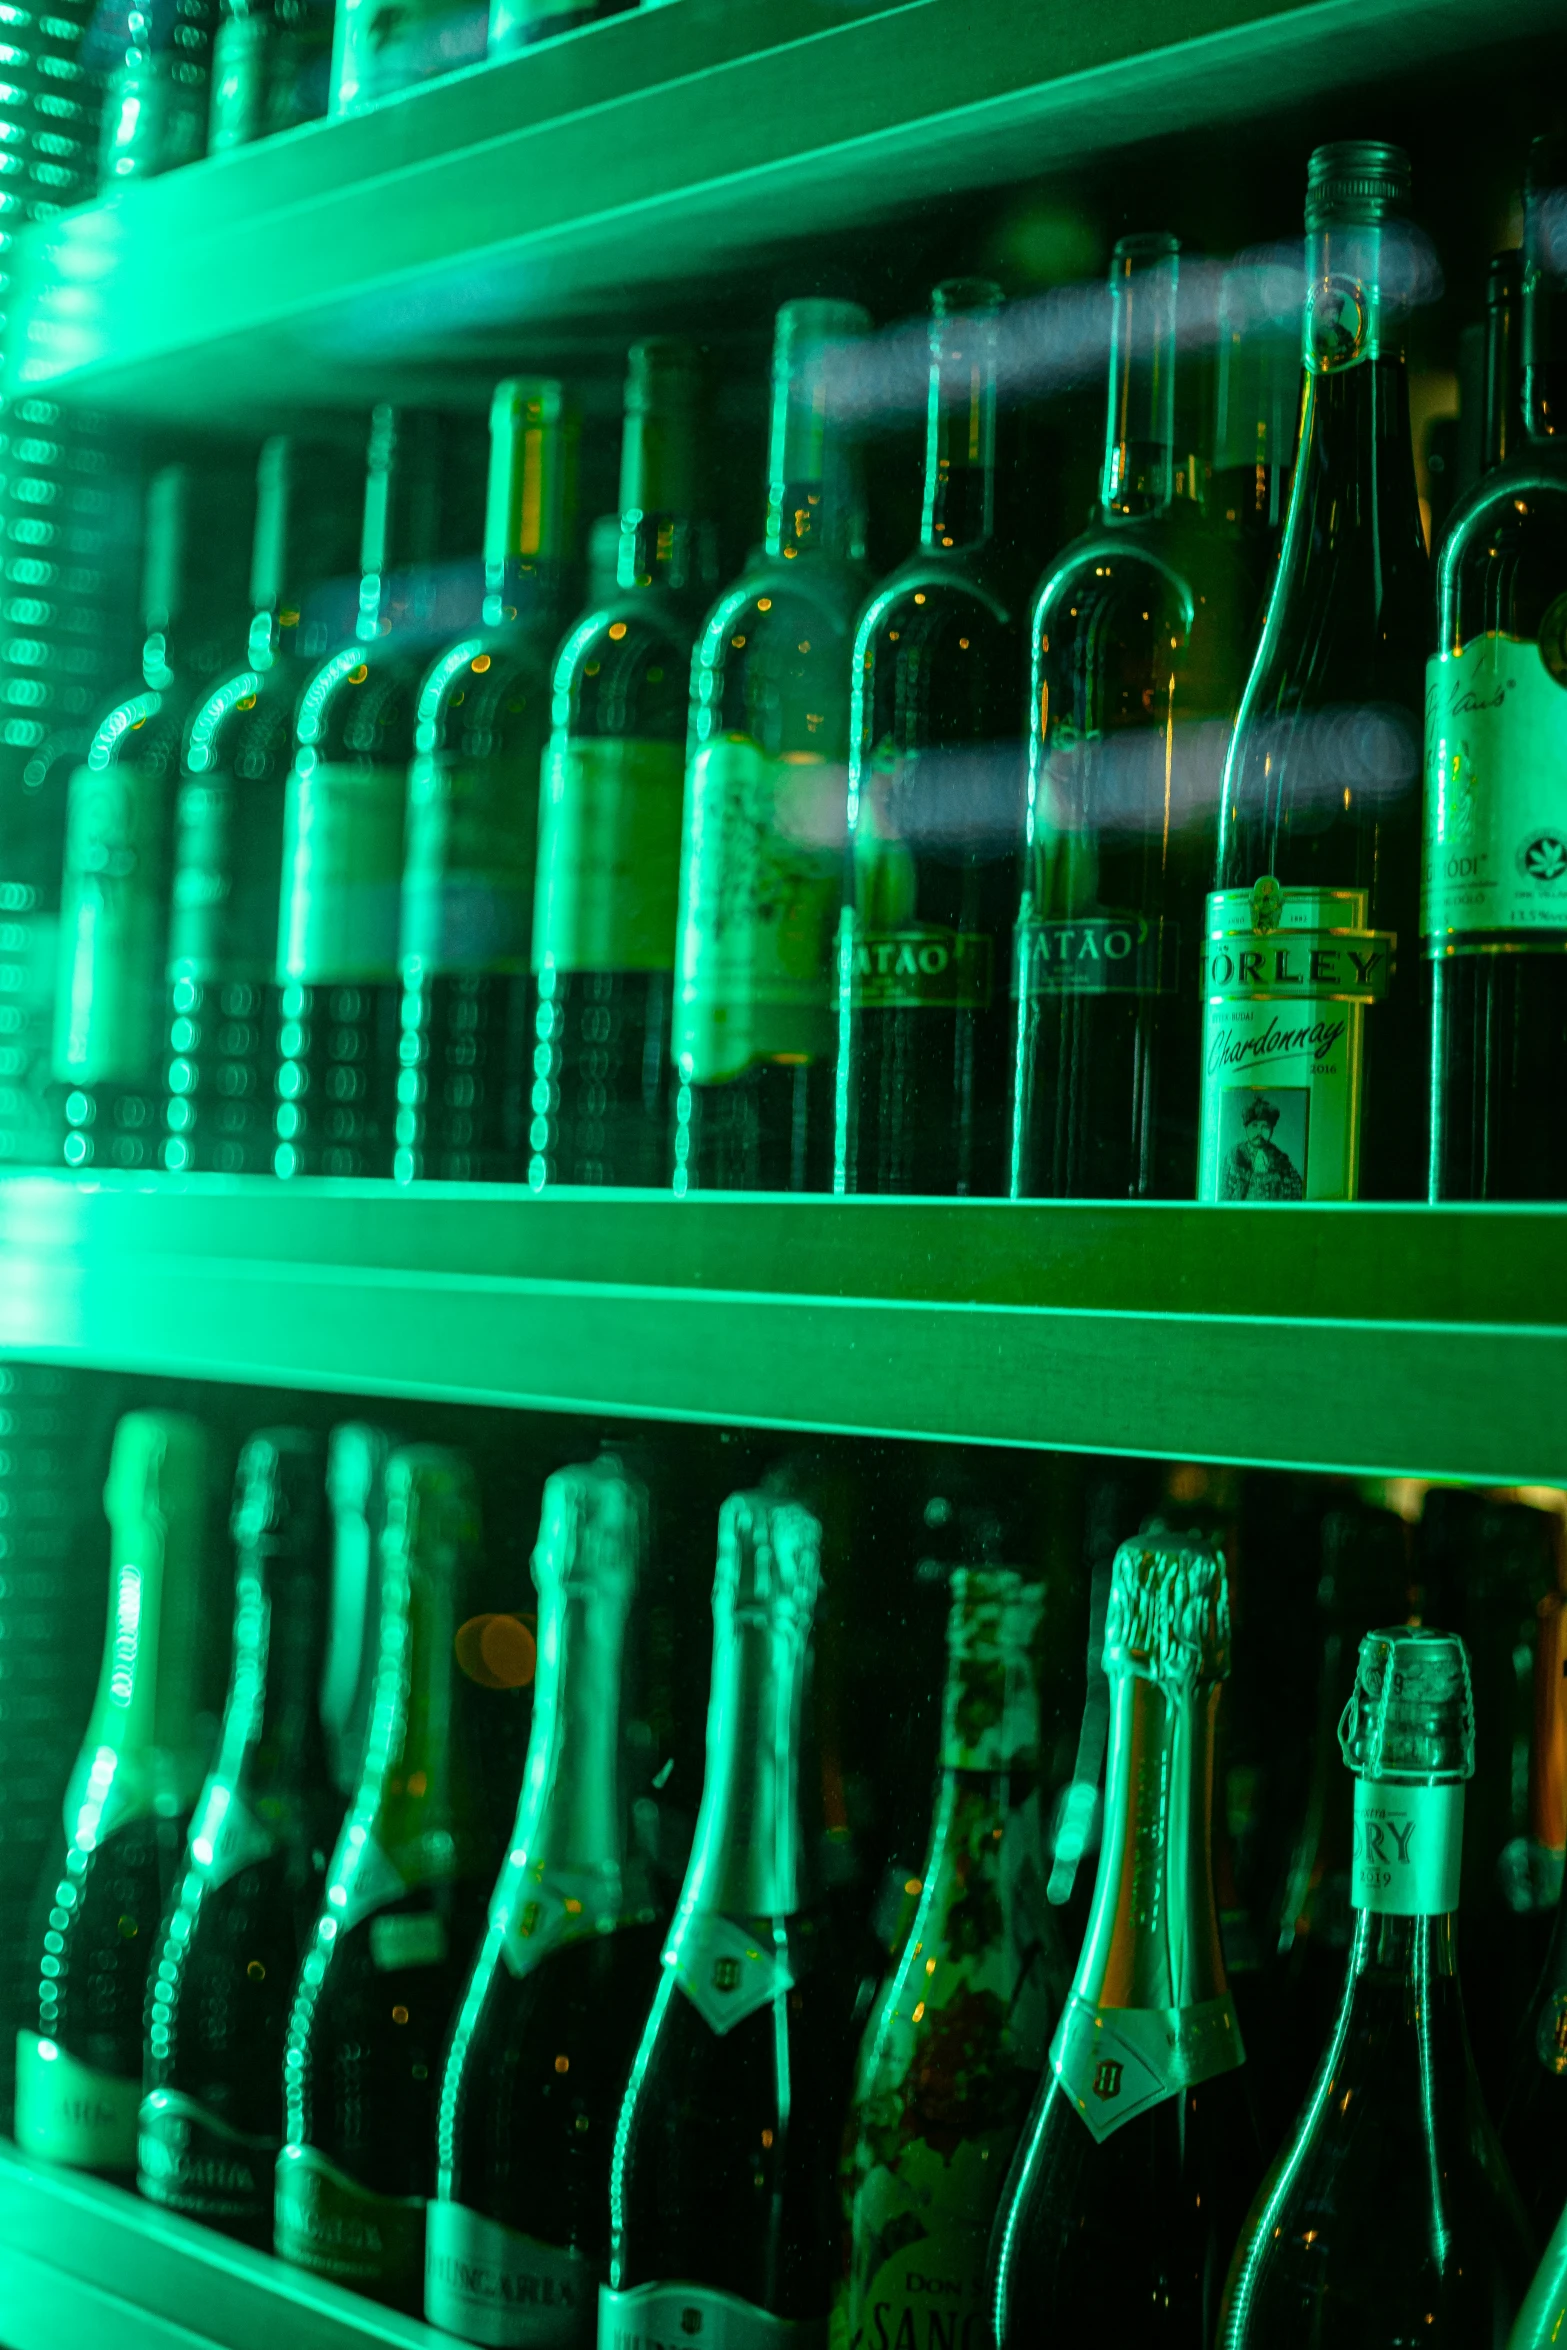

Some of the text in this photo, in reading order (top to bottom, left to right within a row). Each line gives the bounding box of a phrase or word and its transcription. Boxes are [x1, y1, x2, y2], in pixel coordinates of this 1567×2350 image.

[1207, 1014, 1346, 1077] Chardonnay
[1310, 1065, 1337, 1075] 2016
[1359, 1871, 1392, 1888] 2019
